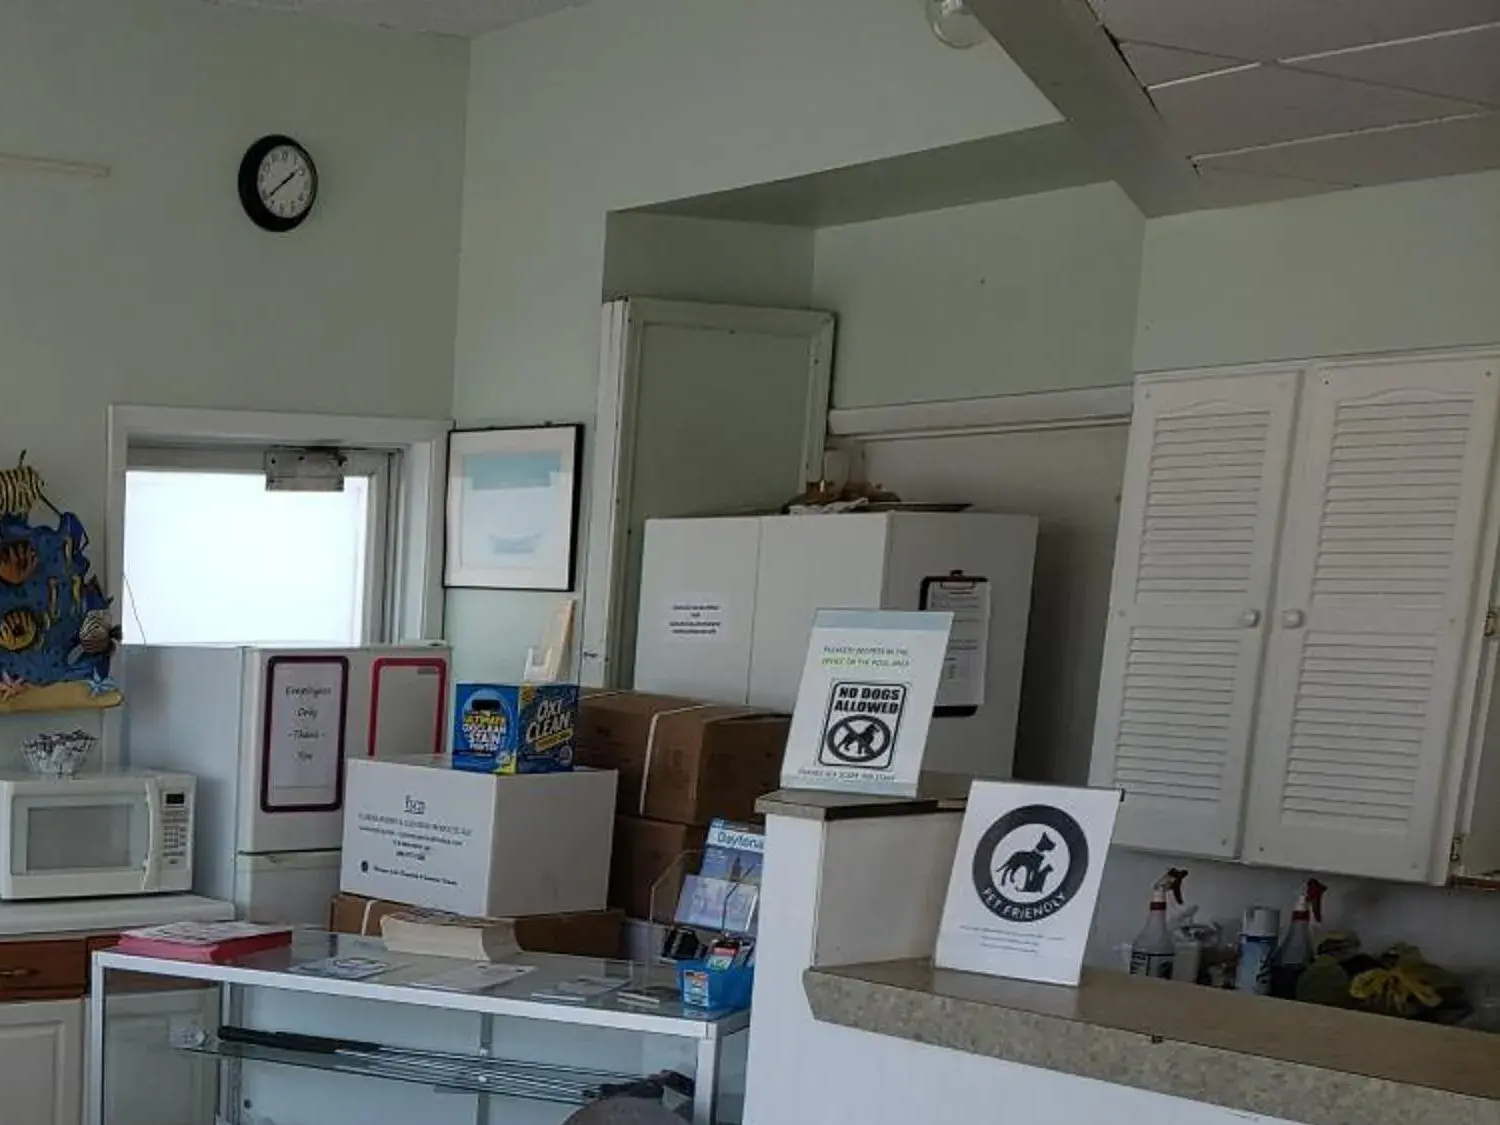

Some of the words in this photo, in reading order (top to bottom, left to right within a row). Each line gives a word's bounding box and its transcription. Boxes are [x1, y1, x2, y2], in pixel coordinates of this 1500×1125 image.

[839, 687, 859, 699] NO
[861, 687, 901, 701] DOGS
[833, 699, 899, 714] ALLOWED
[526, 710, 571, 744] CLEAN
[981, 886, 1002, 909] PET
[1002, 891, 1067, 919] FRIENDLY
